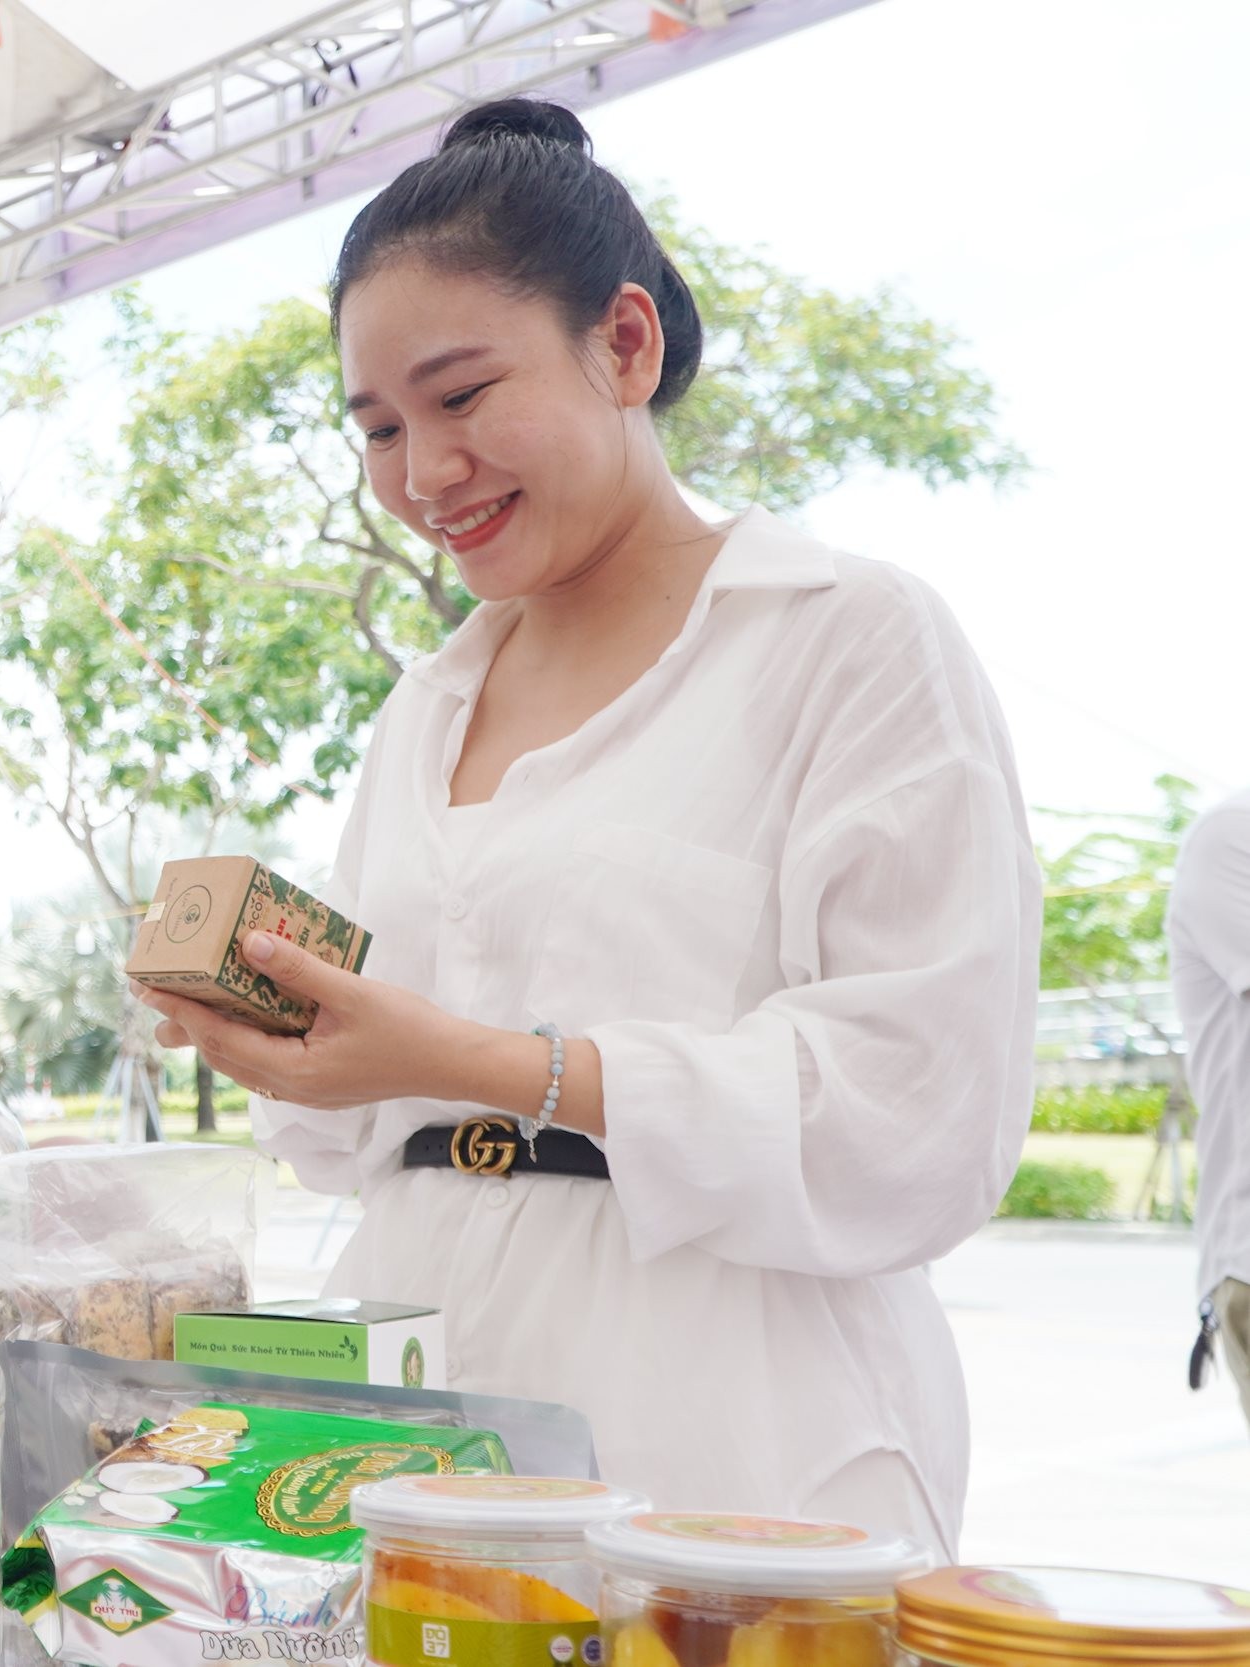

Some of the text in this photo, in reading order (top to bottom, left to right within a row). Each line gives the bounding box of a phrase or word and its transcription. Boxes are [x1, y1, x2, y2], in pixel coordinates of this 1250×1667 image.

[190, 1342, 208, 1351] Món
[210, 1343, 227, 1353] Quà
[232, 1344, 247, 1353] Sức
[290, 1348, 316, 1357] Thiên
[318, 1350, 345, 1360] Nhiên
[94, 1602, 139, 1618] QUÝ THU
[226, 1584, 336, 1629] Bánh
[199, 1624, 361, 1664] Dừa Nướng
[425, 1641, 447, 1655] 37
